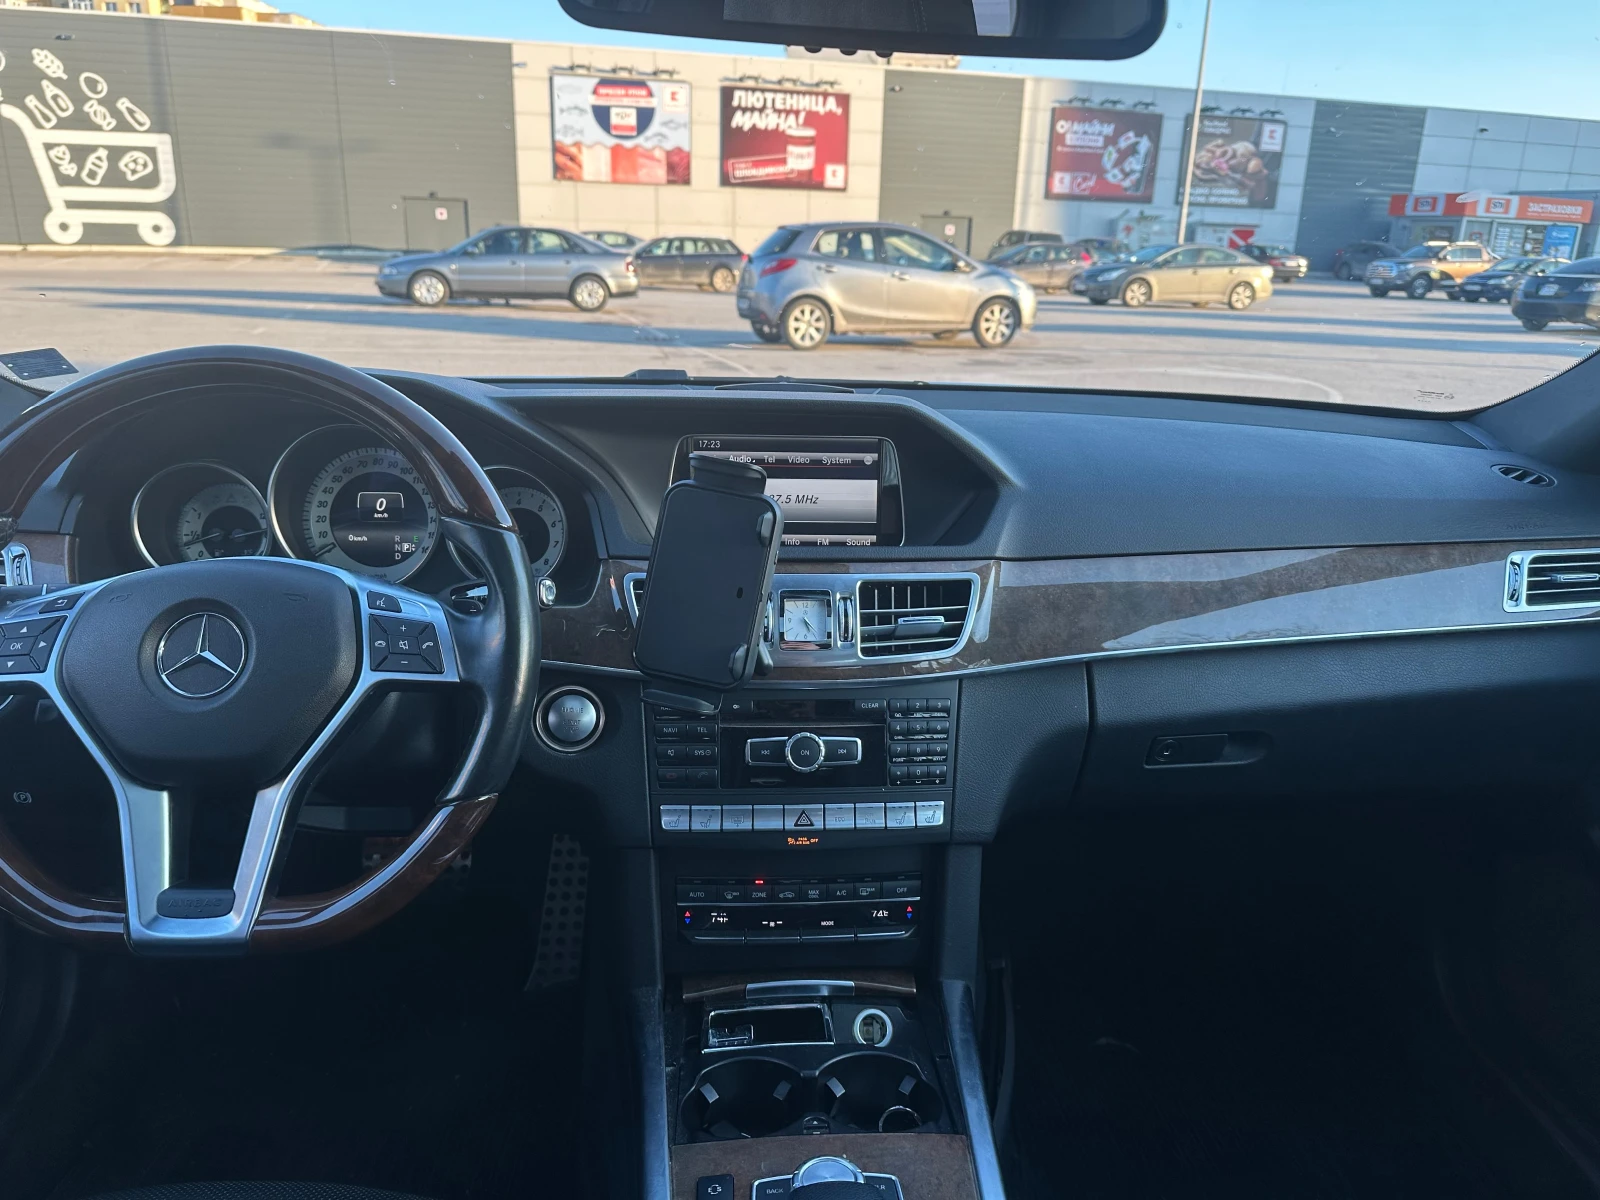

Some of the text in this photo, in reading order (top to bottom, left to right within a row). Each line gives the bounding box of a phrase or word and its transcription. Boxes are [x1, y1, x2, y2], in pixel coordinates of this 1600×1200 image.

[699, 440, 721, 448] 17:23
[372, 458, 384, 466] 80
[729, 454, 752, 463] Audio
[763, 455, 776, 463] Tel
[787, 455, 810, 464] Video
[822, 456, 852, 465] System
[356, 460, 368, 469] 70
[387, 460, 398, 469] 90
[342, 466, 353, 474] 60
[400, 467, 413, 475] 100
[331, 475, 343, 483] 50
[322, 486, 334, 494] 40
[794, 494, 819, 504] MHz
[376, 497, 387, 511] 0
[538, 504, 543, 512] 5
[316, 515, 327, 523] 20
[551, 520, 556, 528] 6
[318, 531, 328, 539] 10
[553, 540, 559, 548] 7
[785, 538, 801, 546] Info
[817, 538, 829, 546] FM
[846, 538, 871, 546] Sound
[10, 642, 23, 650] OK
[168, 898, 222, 908] AIRBAG
